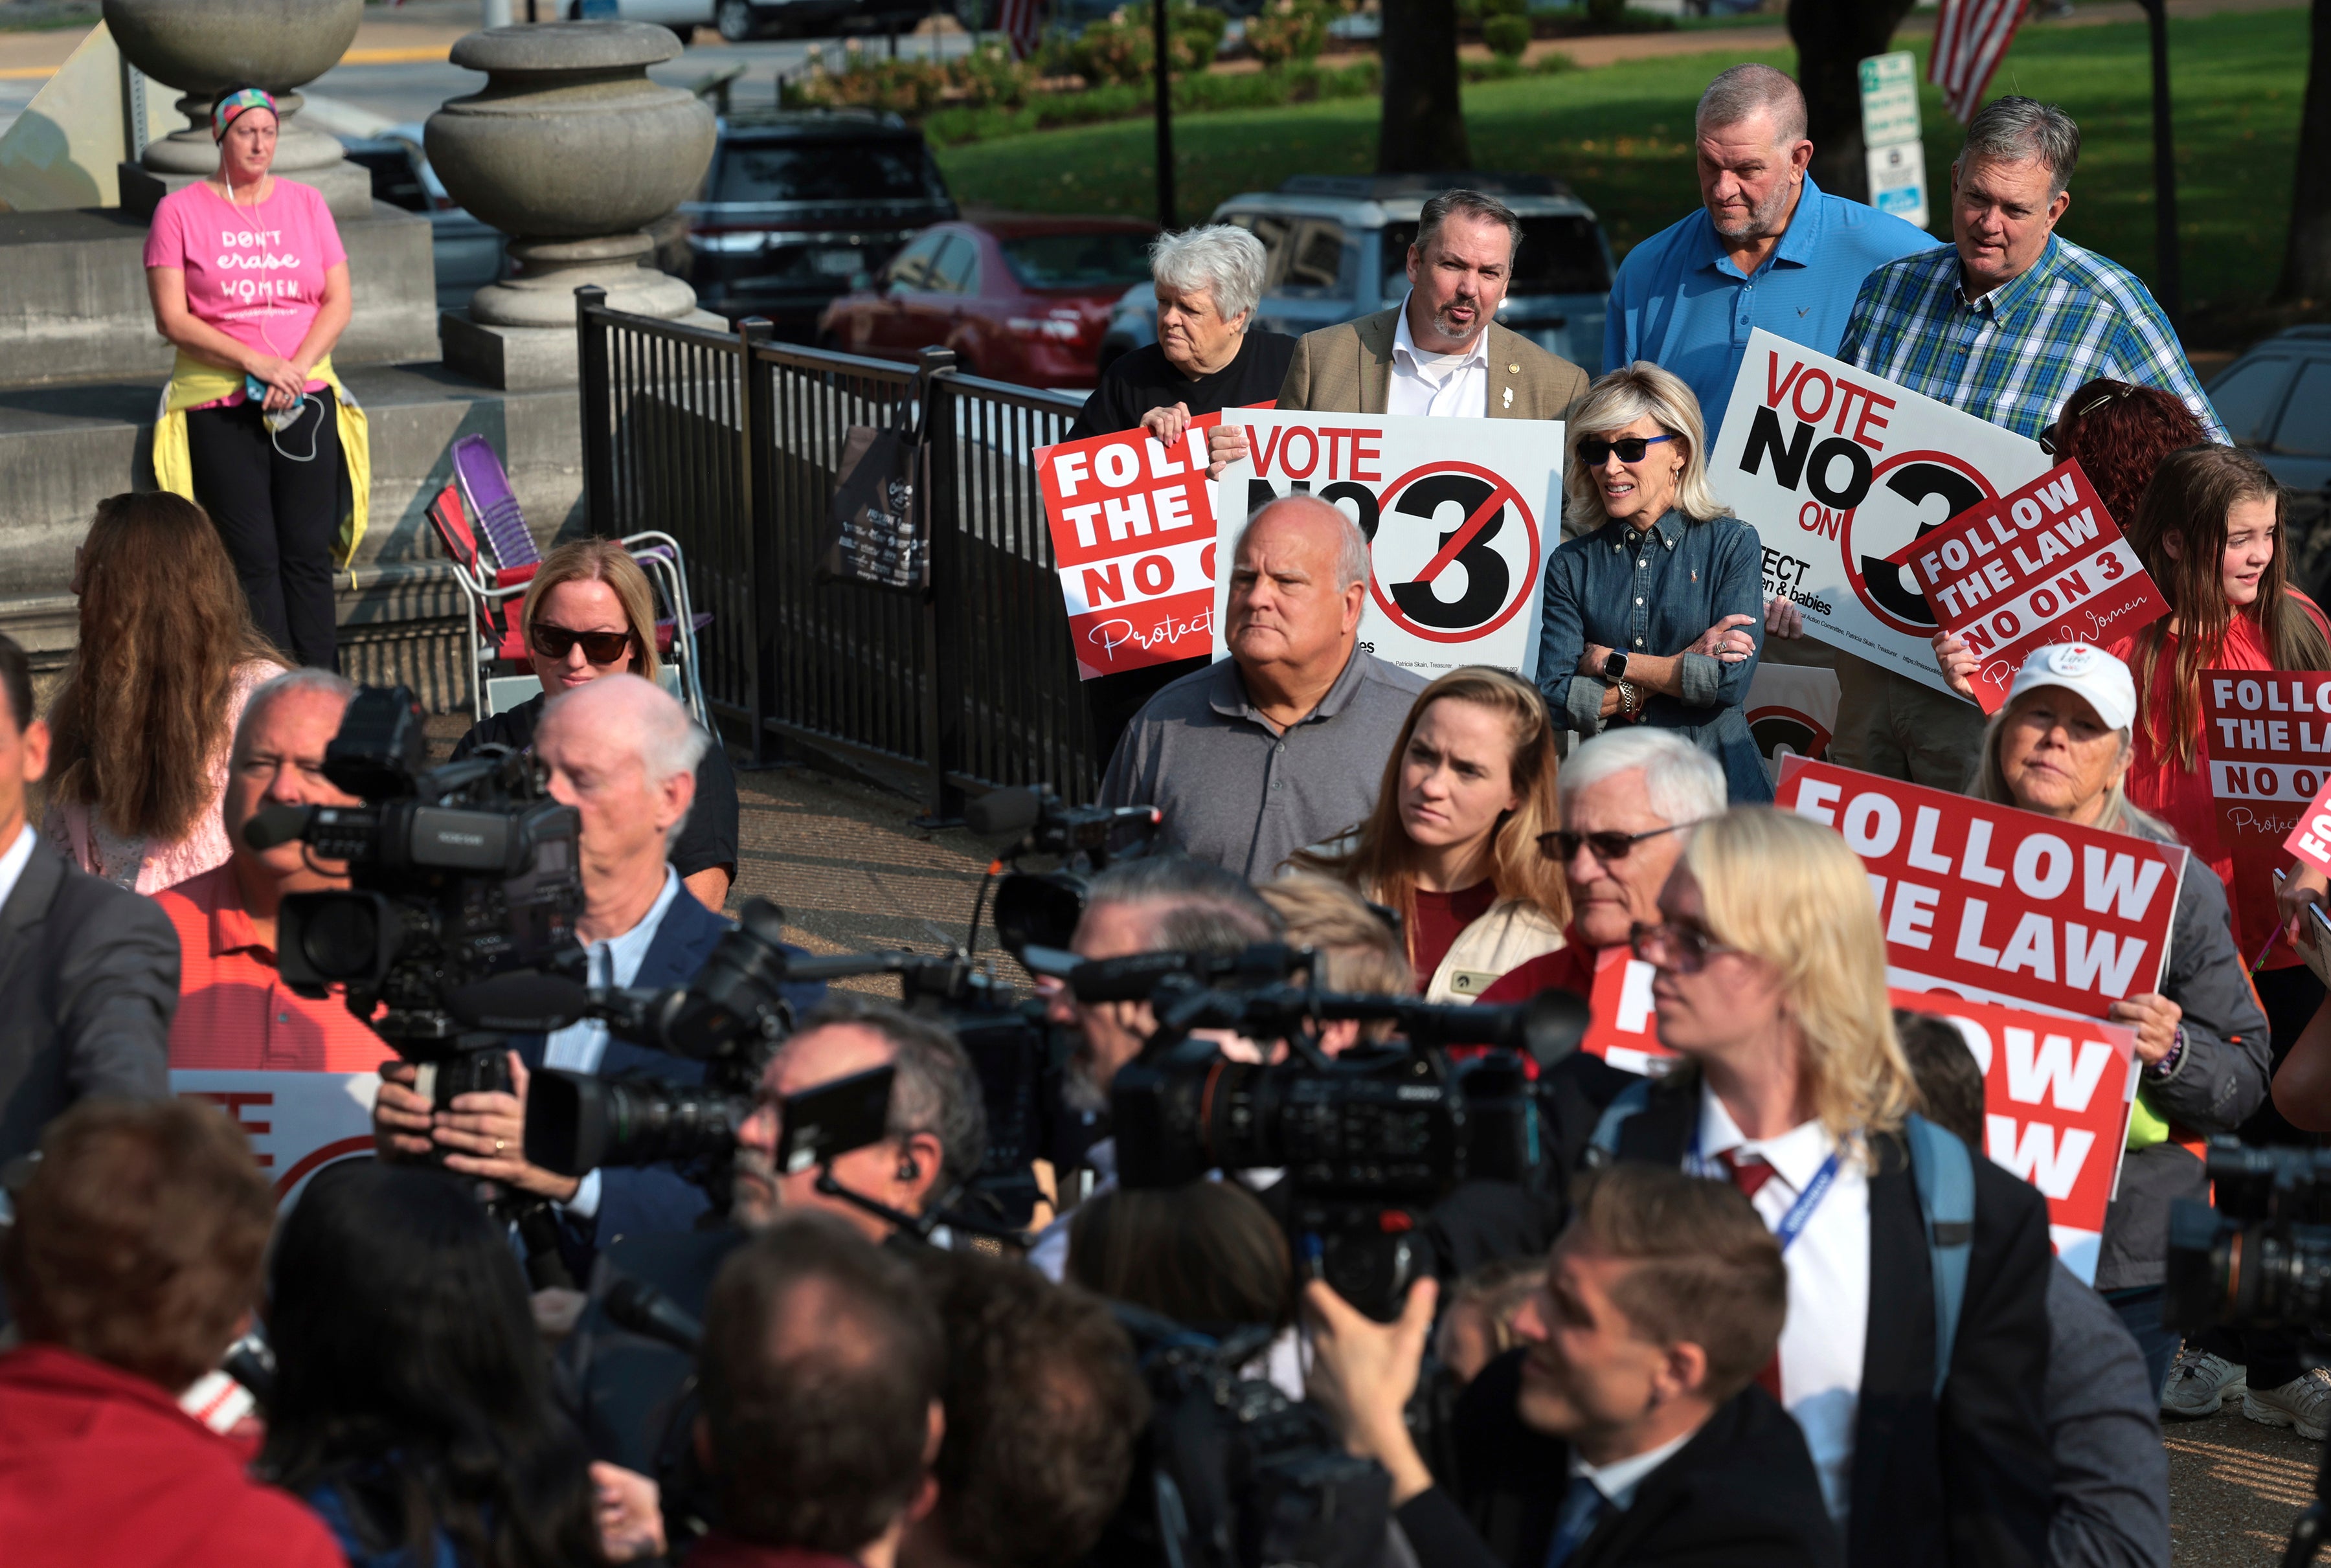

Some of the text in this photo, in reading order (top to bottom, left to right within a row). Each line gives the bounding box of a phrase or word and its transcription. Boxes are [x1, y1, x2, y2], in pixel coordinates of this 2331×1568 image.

[216, 252, 300, 270] erase
[221, 230, 281, 248] DON'T
[1767, 350, 1897, 452] VOTE
[1053, 427, 1210, 498] FOLL
[1244, 425, 1382, 482] VOTE
[1739, 405, 1873, 510] NO
[1062, 484, 1193, 548] THE
[1799, 501, 1842, 541] ON
[1920, 472, 2078, 585] FOLLOW
[1390, 475, 1510, 629] 3
[1935, 506, 2099, 618] THE LAW
[1082, 554, 1175, 608] NO
[1776, 581, 1786, 596] &
[1789, 586, 1832, 615] babies
[1961, 551, 2124, 656] NO ON 3
[1088, 606, 1214, 661] Protect
[1806, 615, 1820, 625] Action
[1821, 621, 1845, 636] Committee,
[1845, 631, 1862, 642] Patricia
[1862, 638, 1875, 649] Skain,
[1877, 644, 1898, 658] Treasurer.
[2060, 596, 2147, 644] Women
[2213, 679, 2331, 713] FOLLO
[2216, 718, 2290, 751] THE
[2225, 765, 2278, 796] NO
[1795, 777, 2167, 922] FOLLOW
[1954, 897, 2148, 1000] LAW
